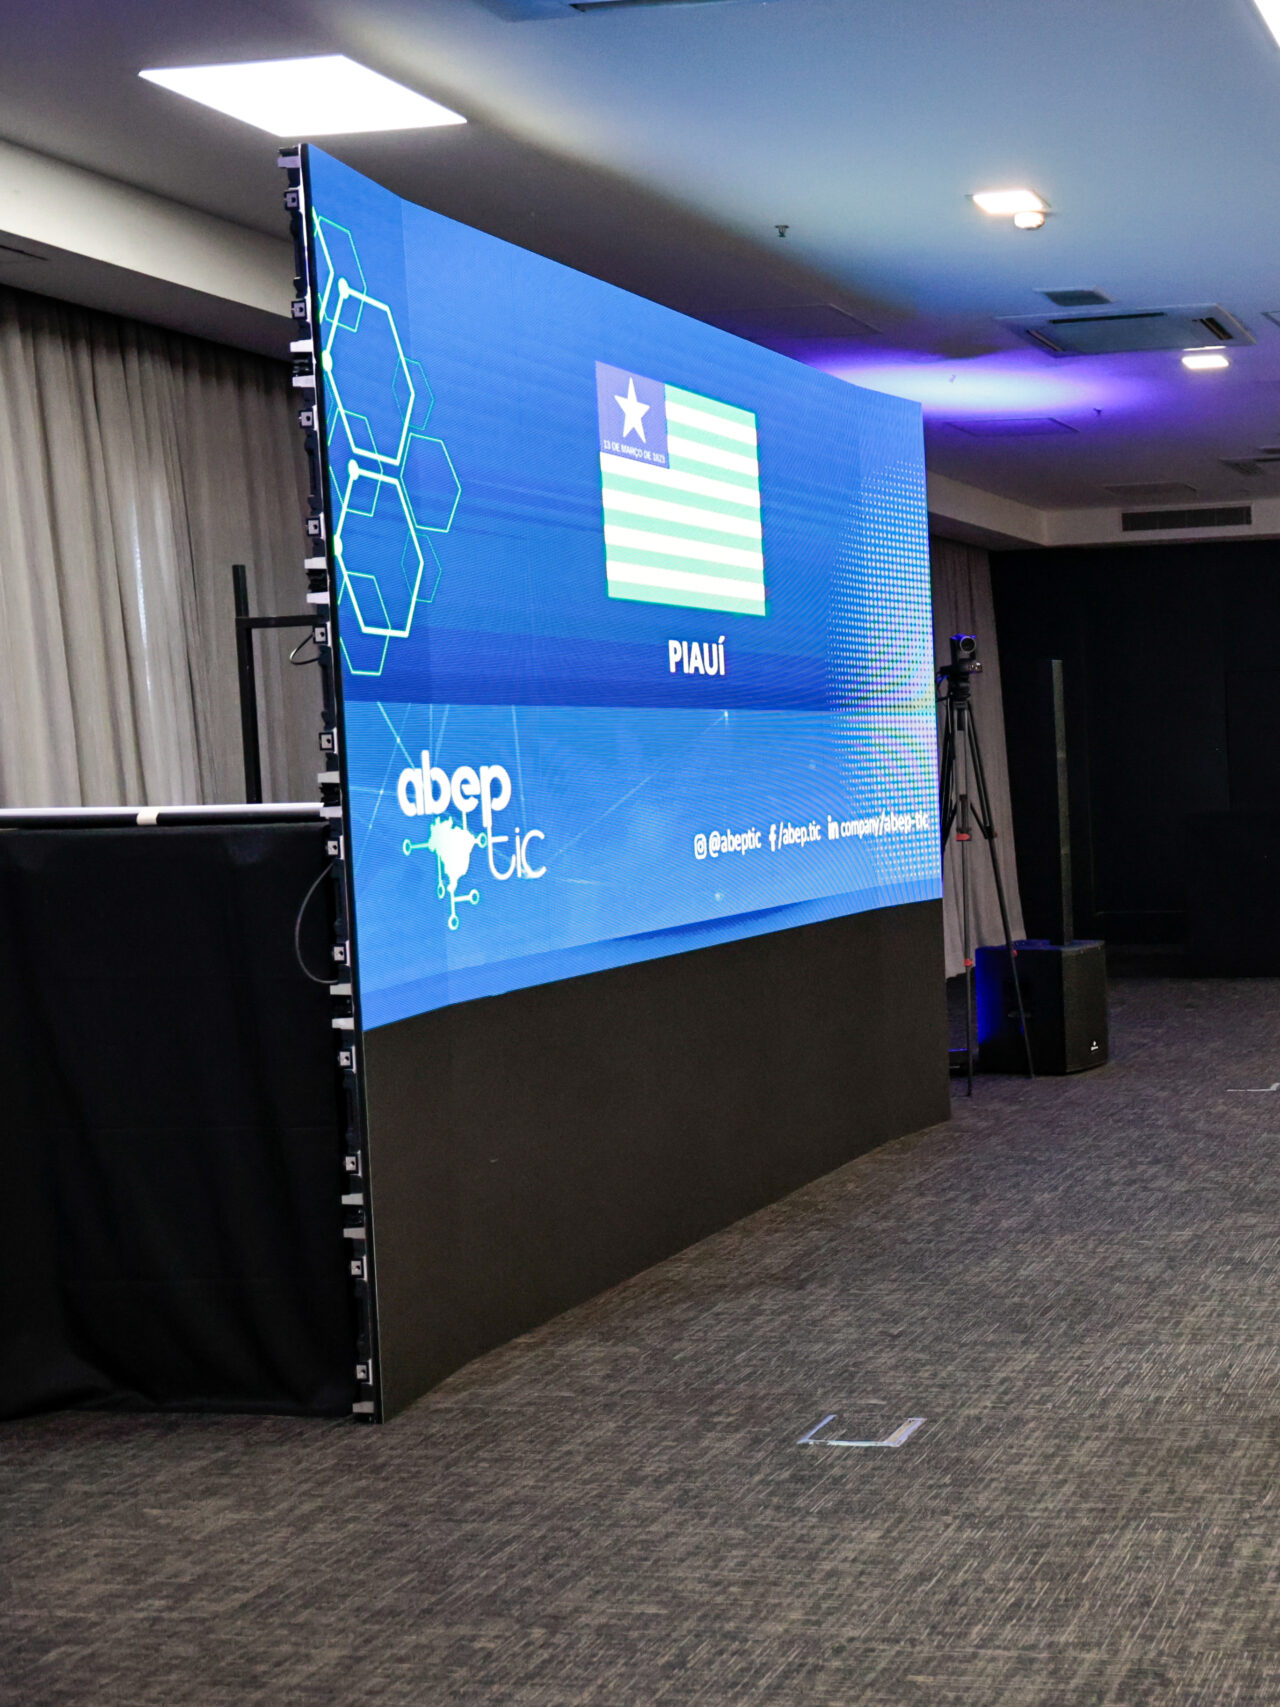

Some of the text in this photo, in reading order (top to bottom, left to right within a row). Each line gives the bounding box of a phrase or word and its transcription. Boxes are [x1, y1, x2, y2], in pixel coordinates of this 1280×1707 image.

[668, 635, 726, 676] PIAUÍ
[397, 749, 512, 828] abep
[487, 826, 547, 881] tic
[708, 826, 762, 858] @abeptic
[777, 821, 821, 848] /abep.tic
